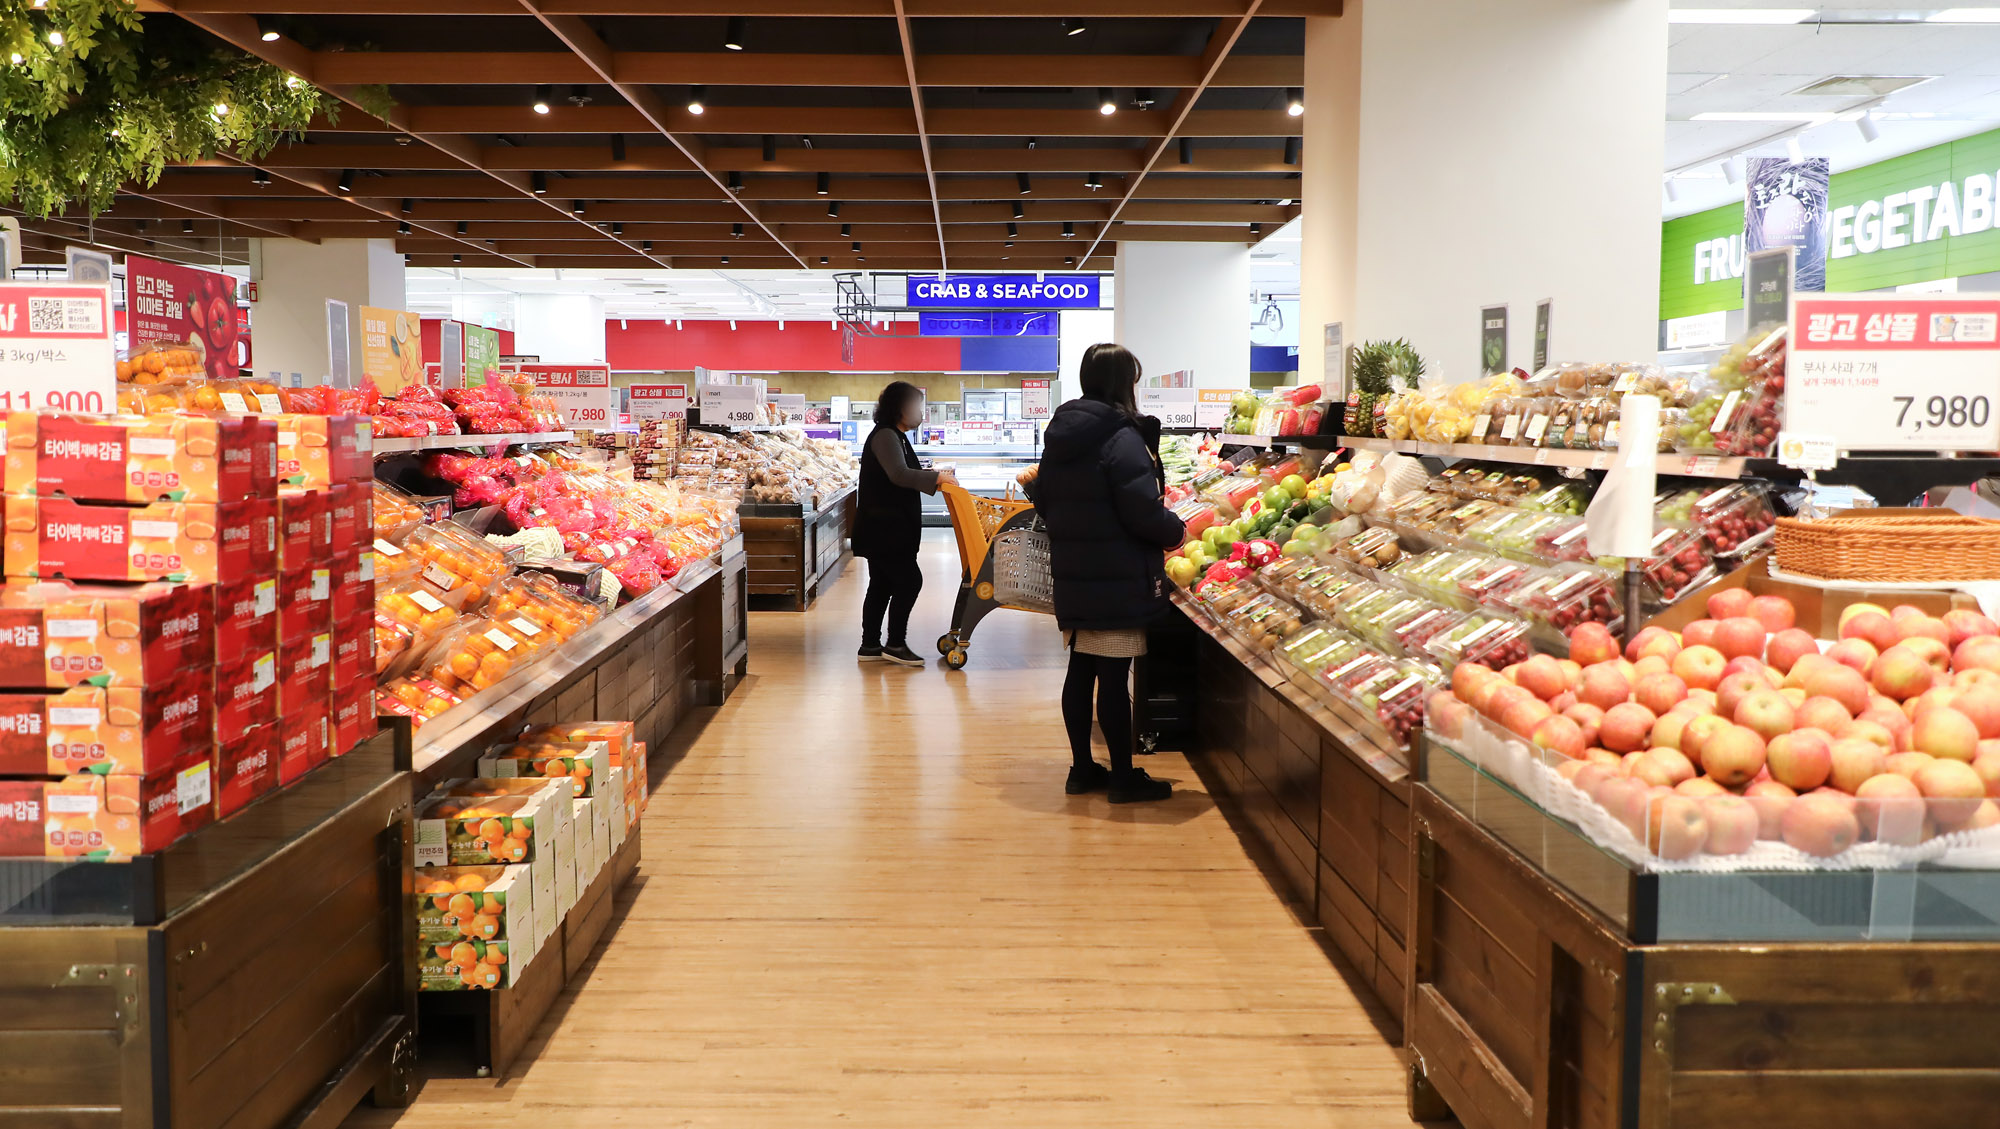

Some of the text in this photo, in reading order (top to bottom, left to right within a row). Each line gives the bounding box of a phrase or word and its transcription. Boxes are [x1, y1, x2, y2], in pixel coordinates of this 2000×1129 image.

[136, 275, 174, 299] 믿고 먹는
[916, 283, 1089, 298] CRAB & SEAFOOD
[136, 296, 183, 320] 이마트 과일
[1807, 313, 1919, 342] 광고 상품
[10, 349, 67, 364] 3kg/박스
[1803, 361, 1878, 374] 부사 사과 7개
[550, 372, 572, 384] 행사
[570, 408, 606, 423] 7,980
[727, 412, 754, 422] 4,980
[1166, 414, 1193, 424] 5,980
[1892, 395, 1990, 432] 7,980
[45, 439, 122, 461] 타이백 재배 감귤
[46, 523, 124, 543] 타이백 재배 감귤
[13, 626, 39, 647] 감귤
[16, 713, 42, 734] 감귤
[14, 801, 39, 821] 감귤
